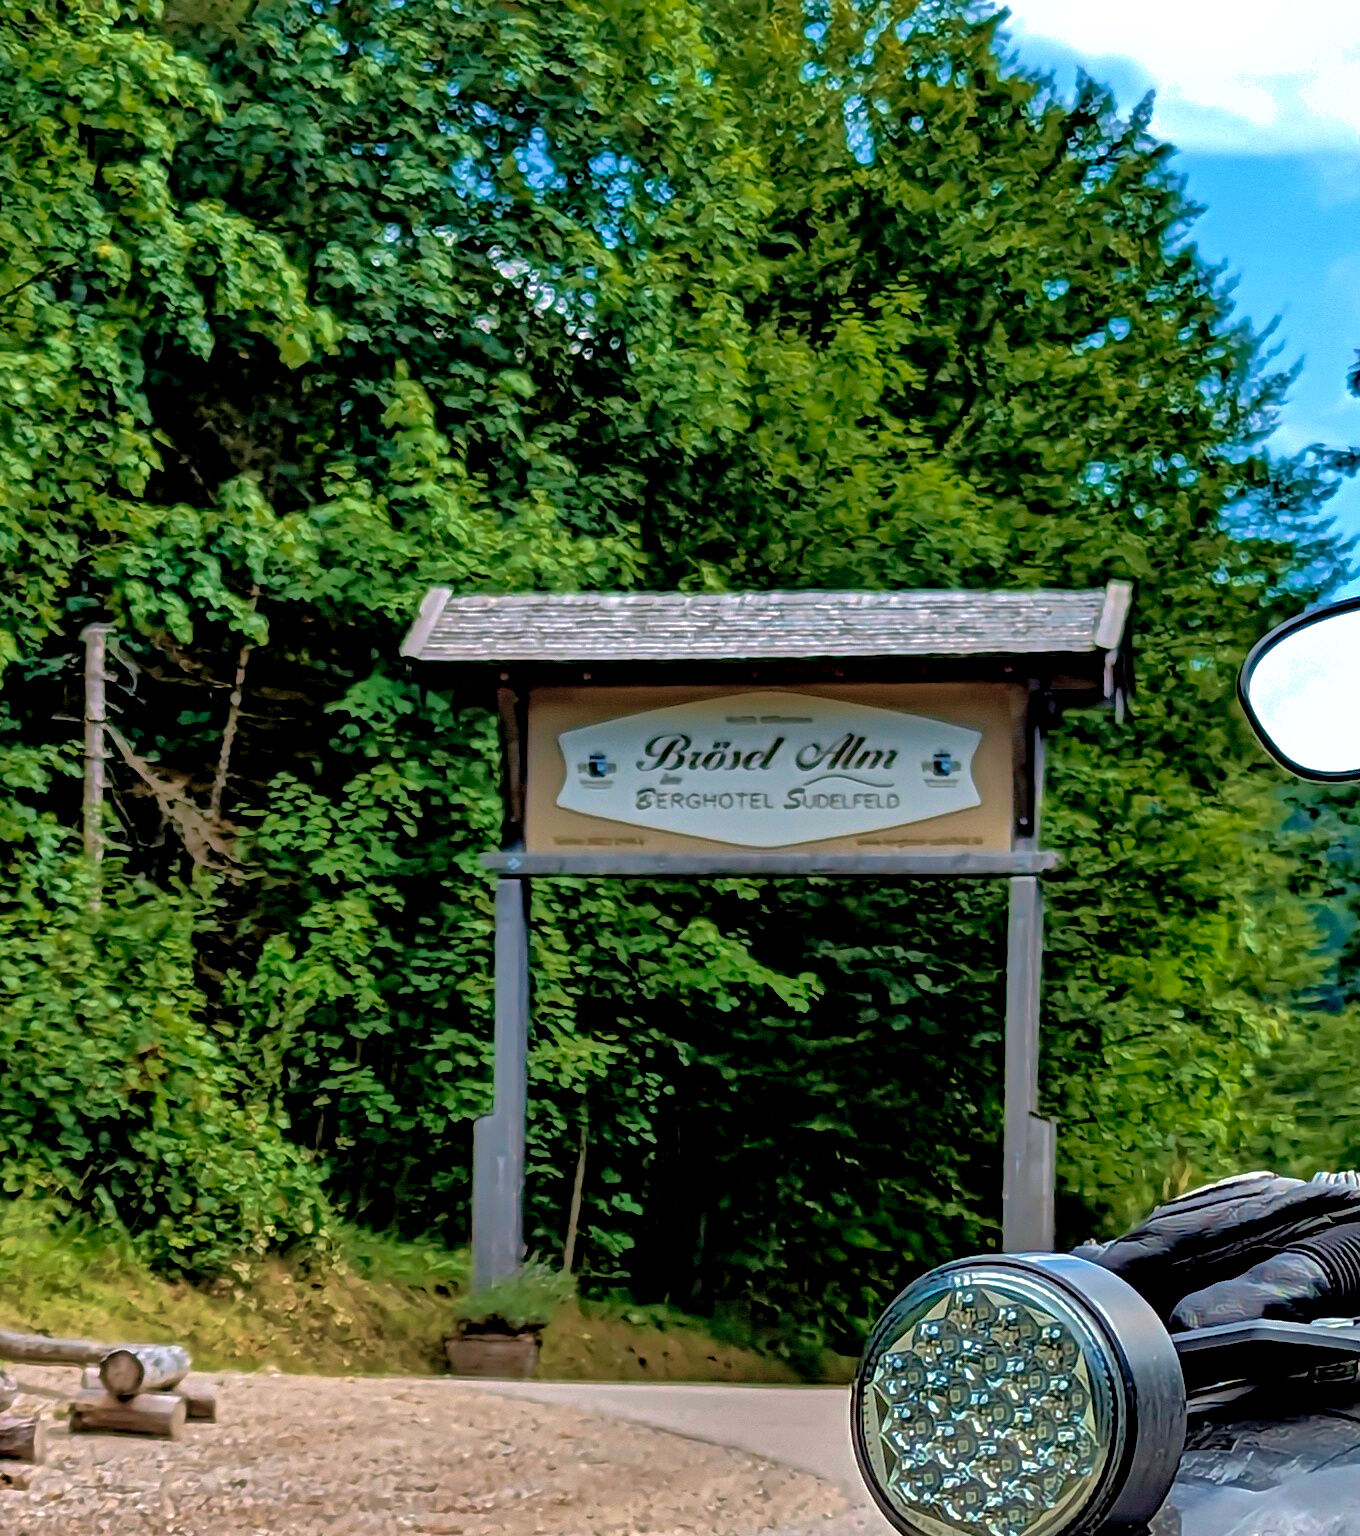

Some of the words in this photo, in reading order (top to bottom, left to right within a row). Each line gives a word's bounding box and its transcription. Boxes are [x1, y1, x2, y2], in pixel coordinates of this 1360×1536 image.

[636, 732, 786, 771] Brösel
[795, 731, 899, 771] Alm
[635, 787, 774, 810] BERGHOTEL
